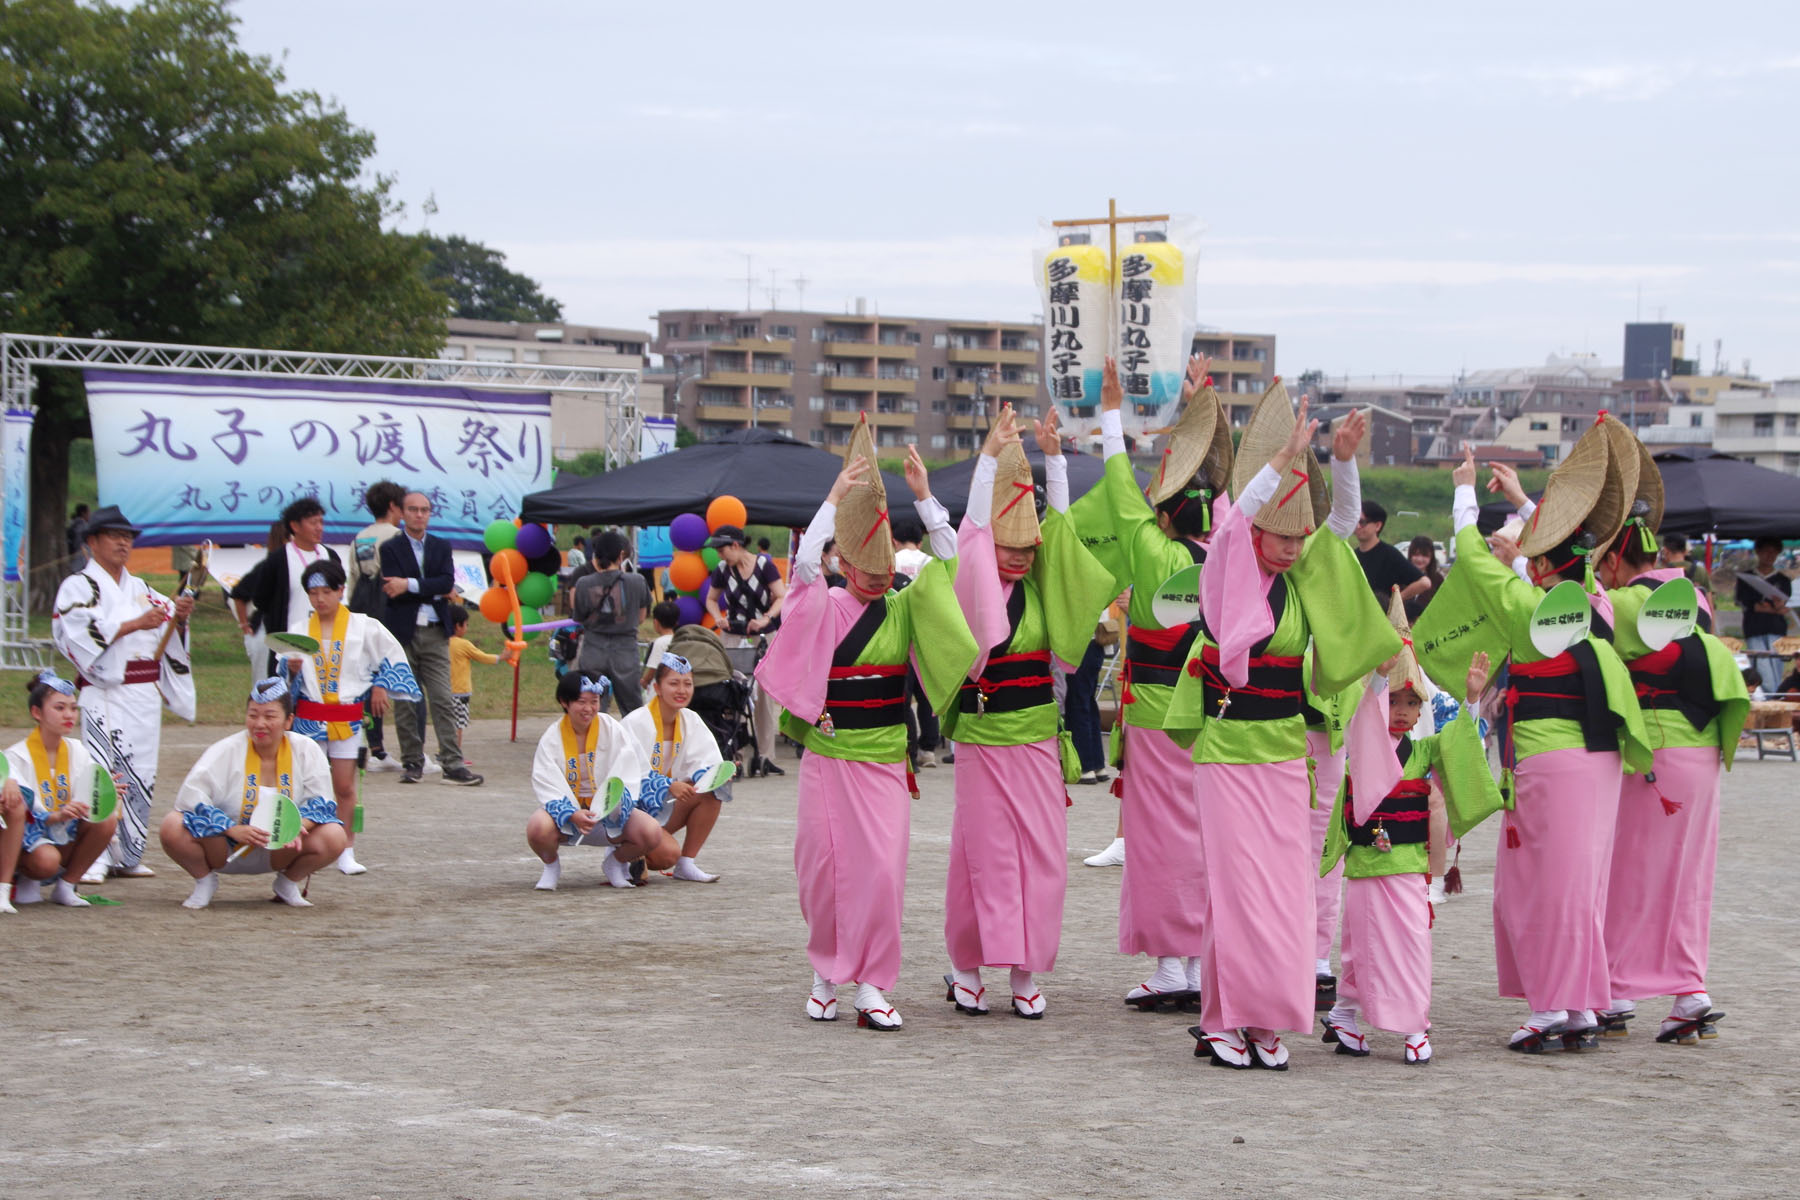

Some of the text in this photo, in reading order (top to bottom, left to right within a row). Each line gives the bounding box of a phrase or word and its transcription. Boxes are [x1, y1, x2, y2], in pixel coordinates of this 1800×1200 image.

[1048, 257, 1083, 399] 多摩川丸子連
[1120, 254, 1152, 396] 多摩川丸子連
[119, 407, 543, 483] 丸子の渡し祭り
[171, 479, 517, 523] 丸子の渡し実委員会
[315, 649, 327, 695] りこ連
